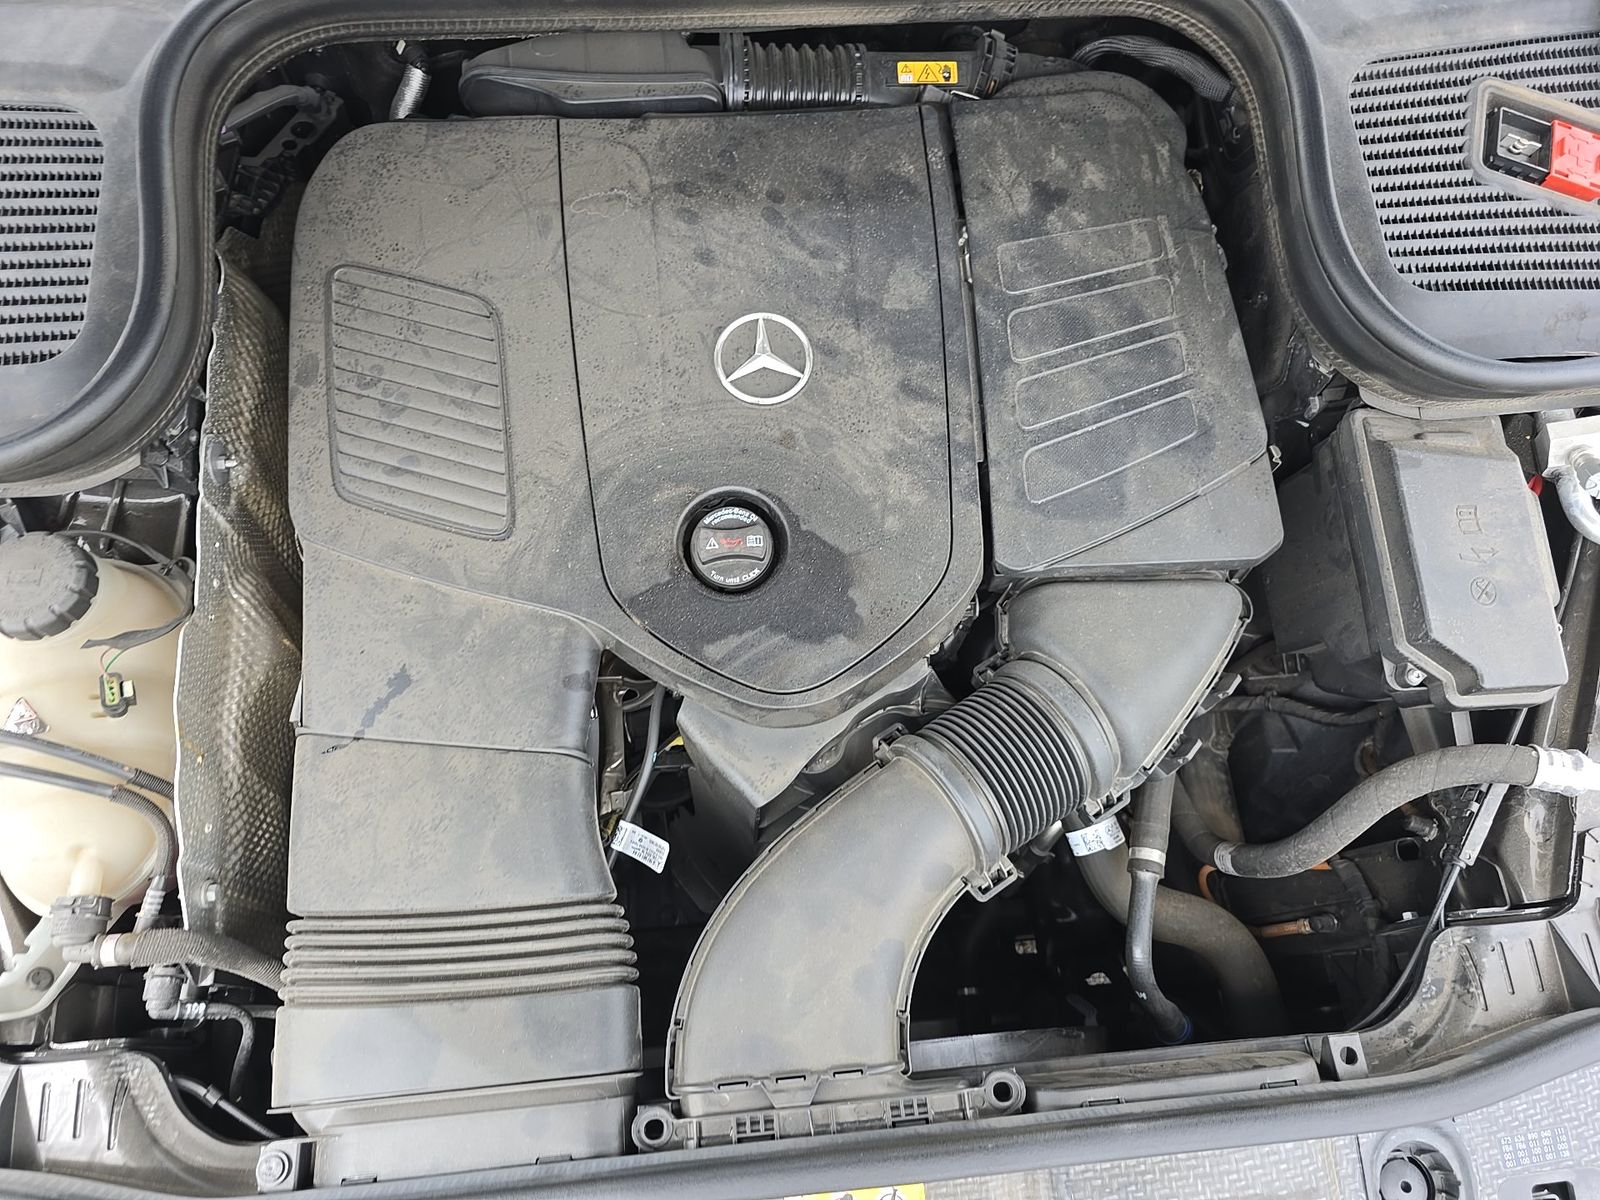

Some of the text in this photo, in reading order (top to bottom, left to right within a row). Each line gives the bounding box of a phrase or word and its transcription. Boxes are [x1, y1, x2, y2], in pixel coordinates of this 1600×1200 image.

[704, 508, 749, 524] Mercedes-Benz
[712, 514, 751, 525] recommended
[711, 570, 723, 580] Turn
[742, 568, 760, 580] CLICK
[1504, 1152, 1514, 1160] 001
[1506, 1160, 1516, 1168] 001
